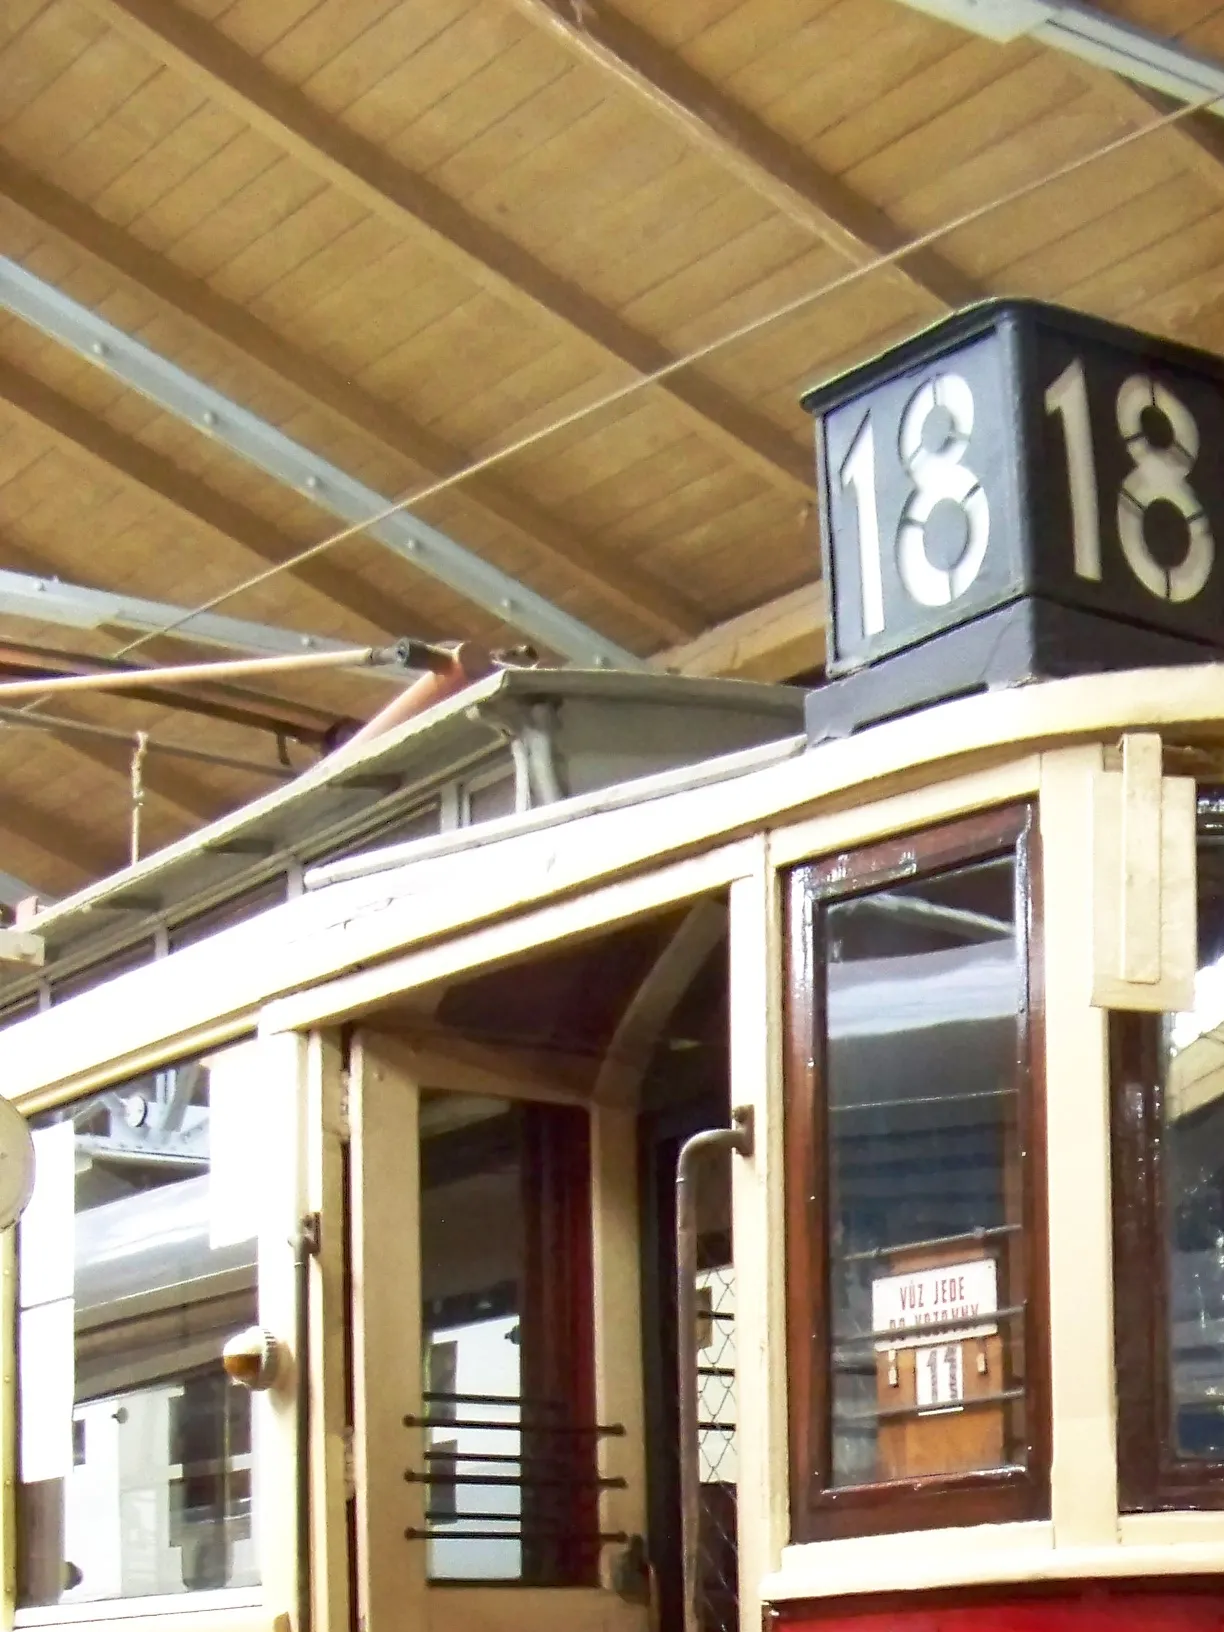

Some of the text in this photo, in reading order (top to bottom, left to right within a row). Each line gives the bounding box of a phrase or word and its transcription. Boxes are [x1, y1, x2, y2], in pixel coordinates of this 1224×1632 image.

[839, 373, 990, 636] 18
[1044, 355, 1215, 603] 18
[933, 1276, 965, 1305] JEDE
[926, 1344, 959, 1406] 11
